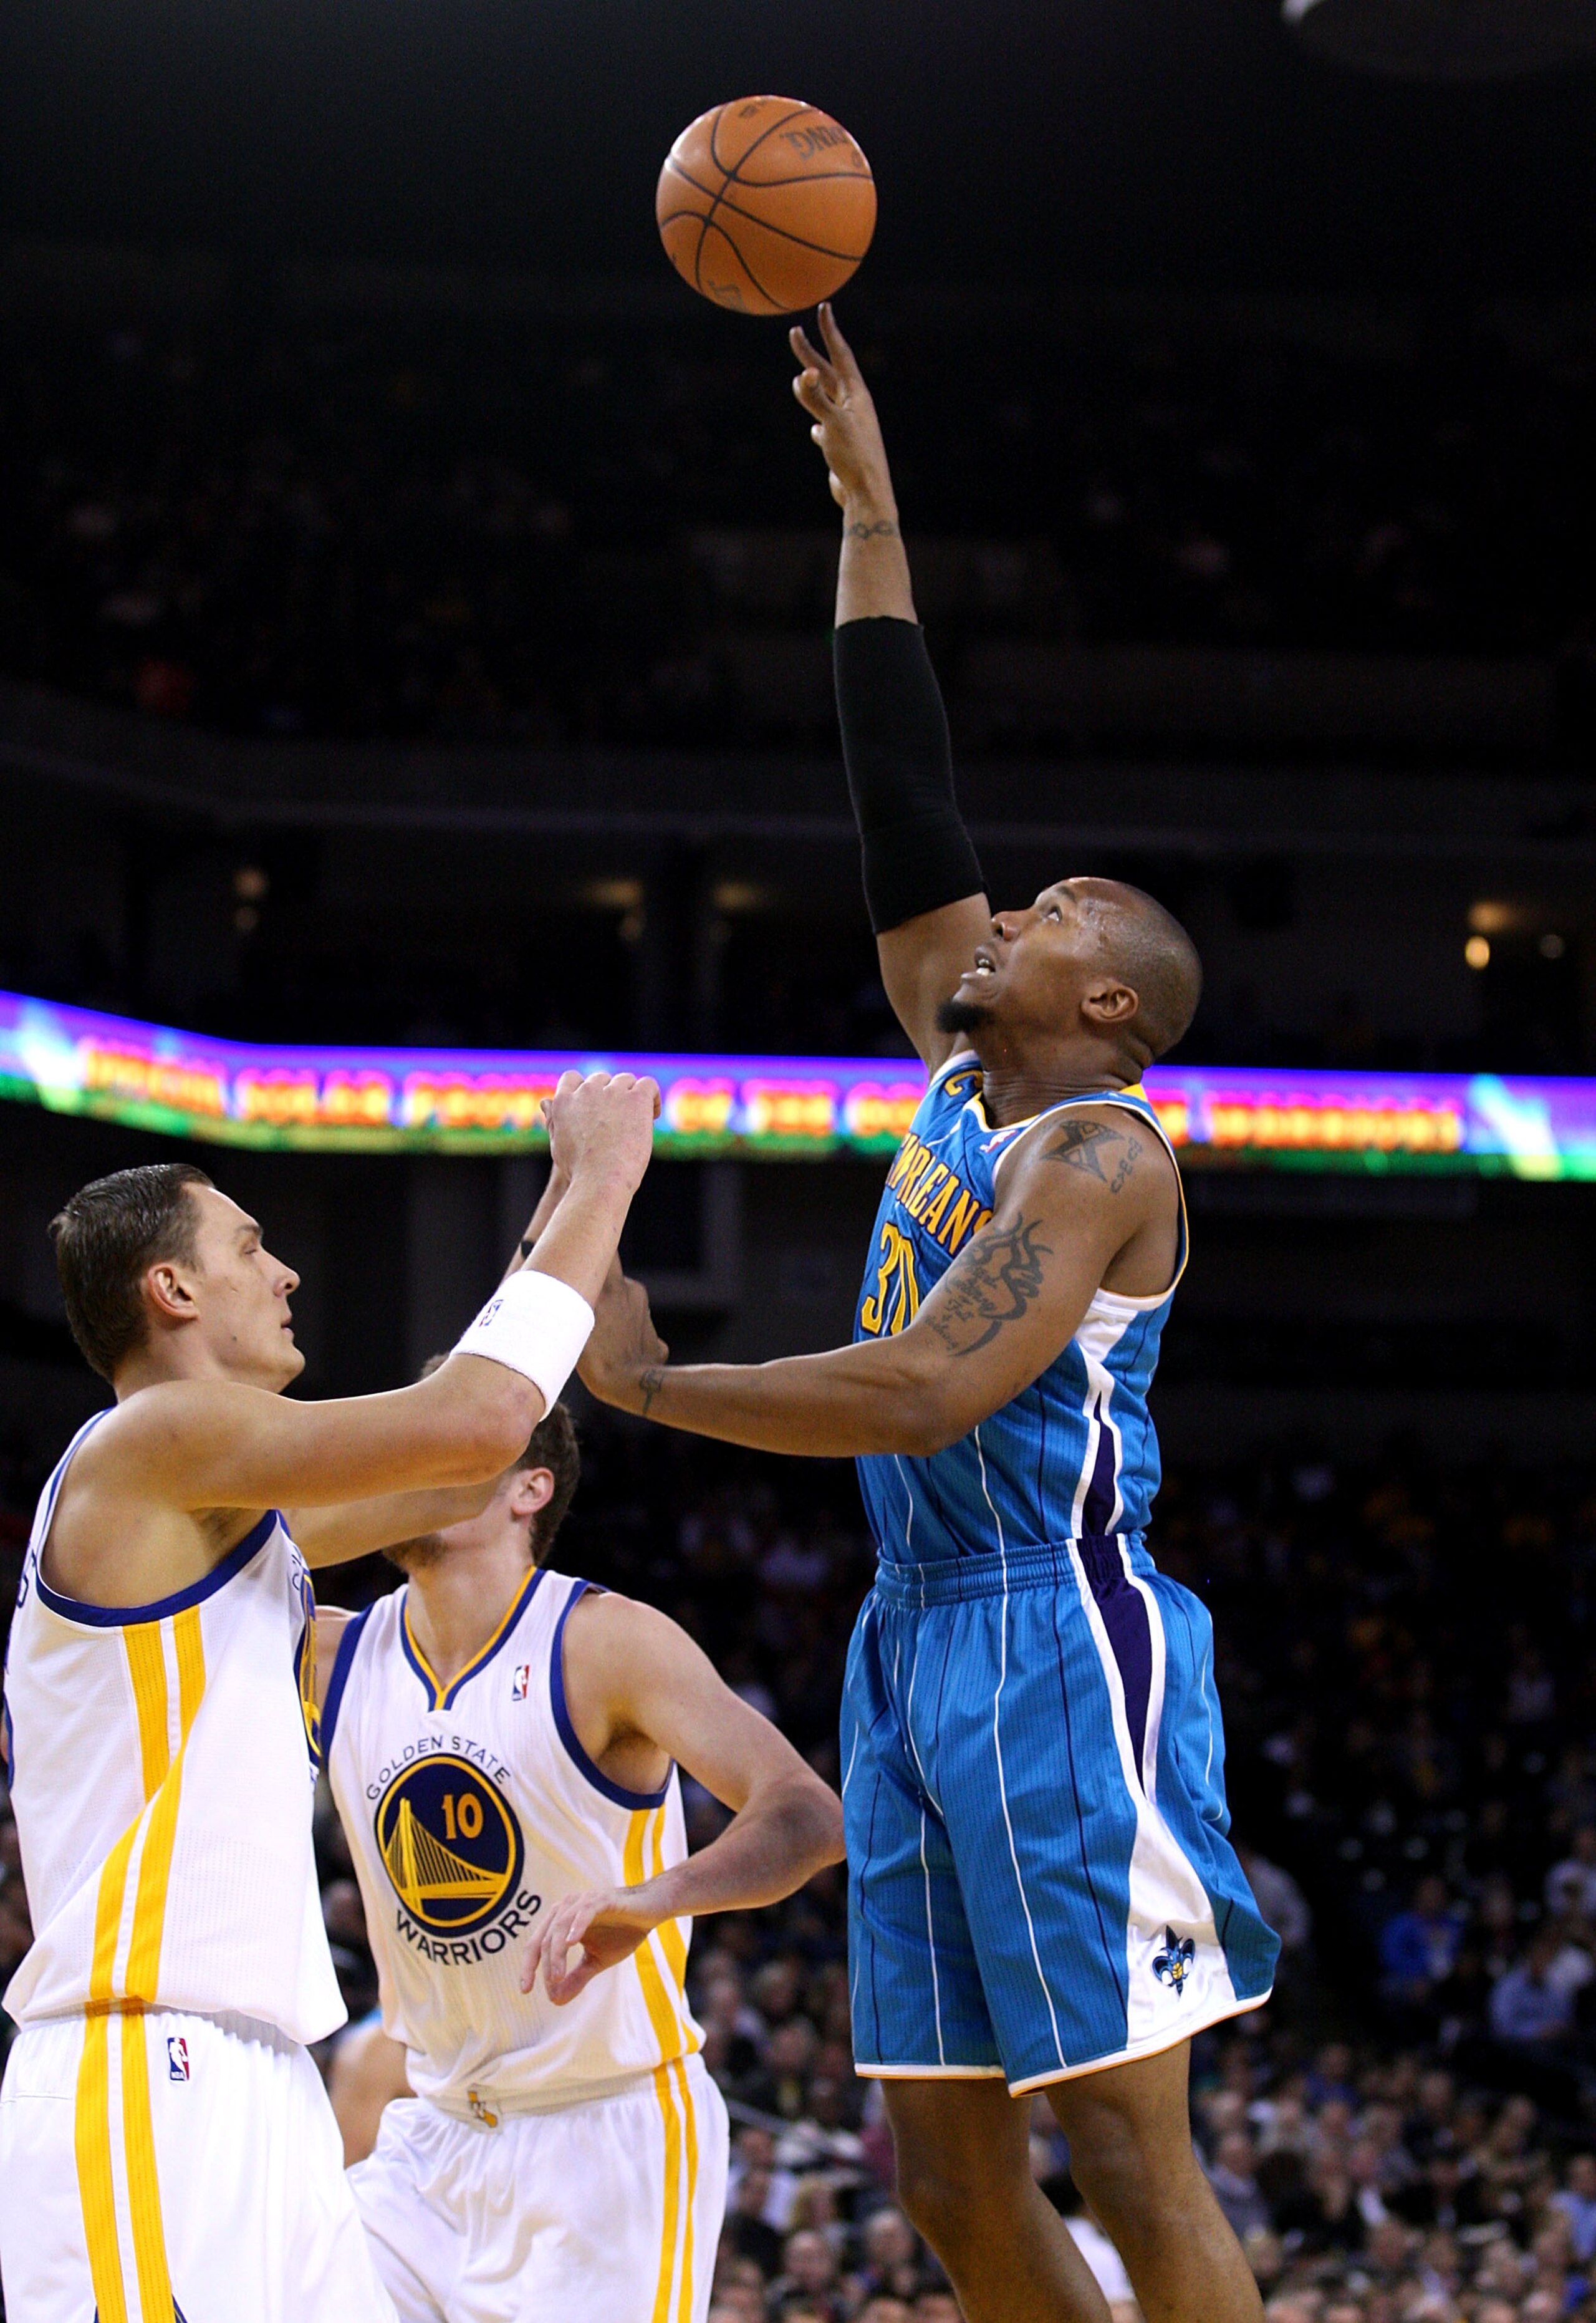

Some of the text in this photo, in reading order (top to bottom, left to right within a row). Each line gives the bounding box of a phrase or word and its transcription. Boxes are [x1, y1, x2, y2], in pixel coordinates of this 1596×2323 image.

[861, 1223, 920, 1336] 30
[367, 1735, 511, 1800] GOLDEN STATE
[441, 1793, 483, 1840] 10
[397, 1890, 541, 1966] WARRIORS
